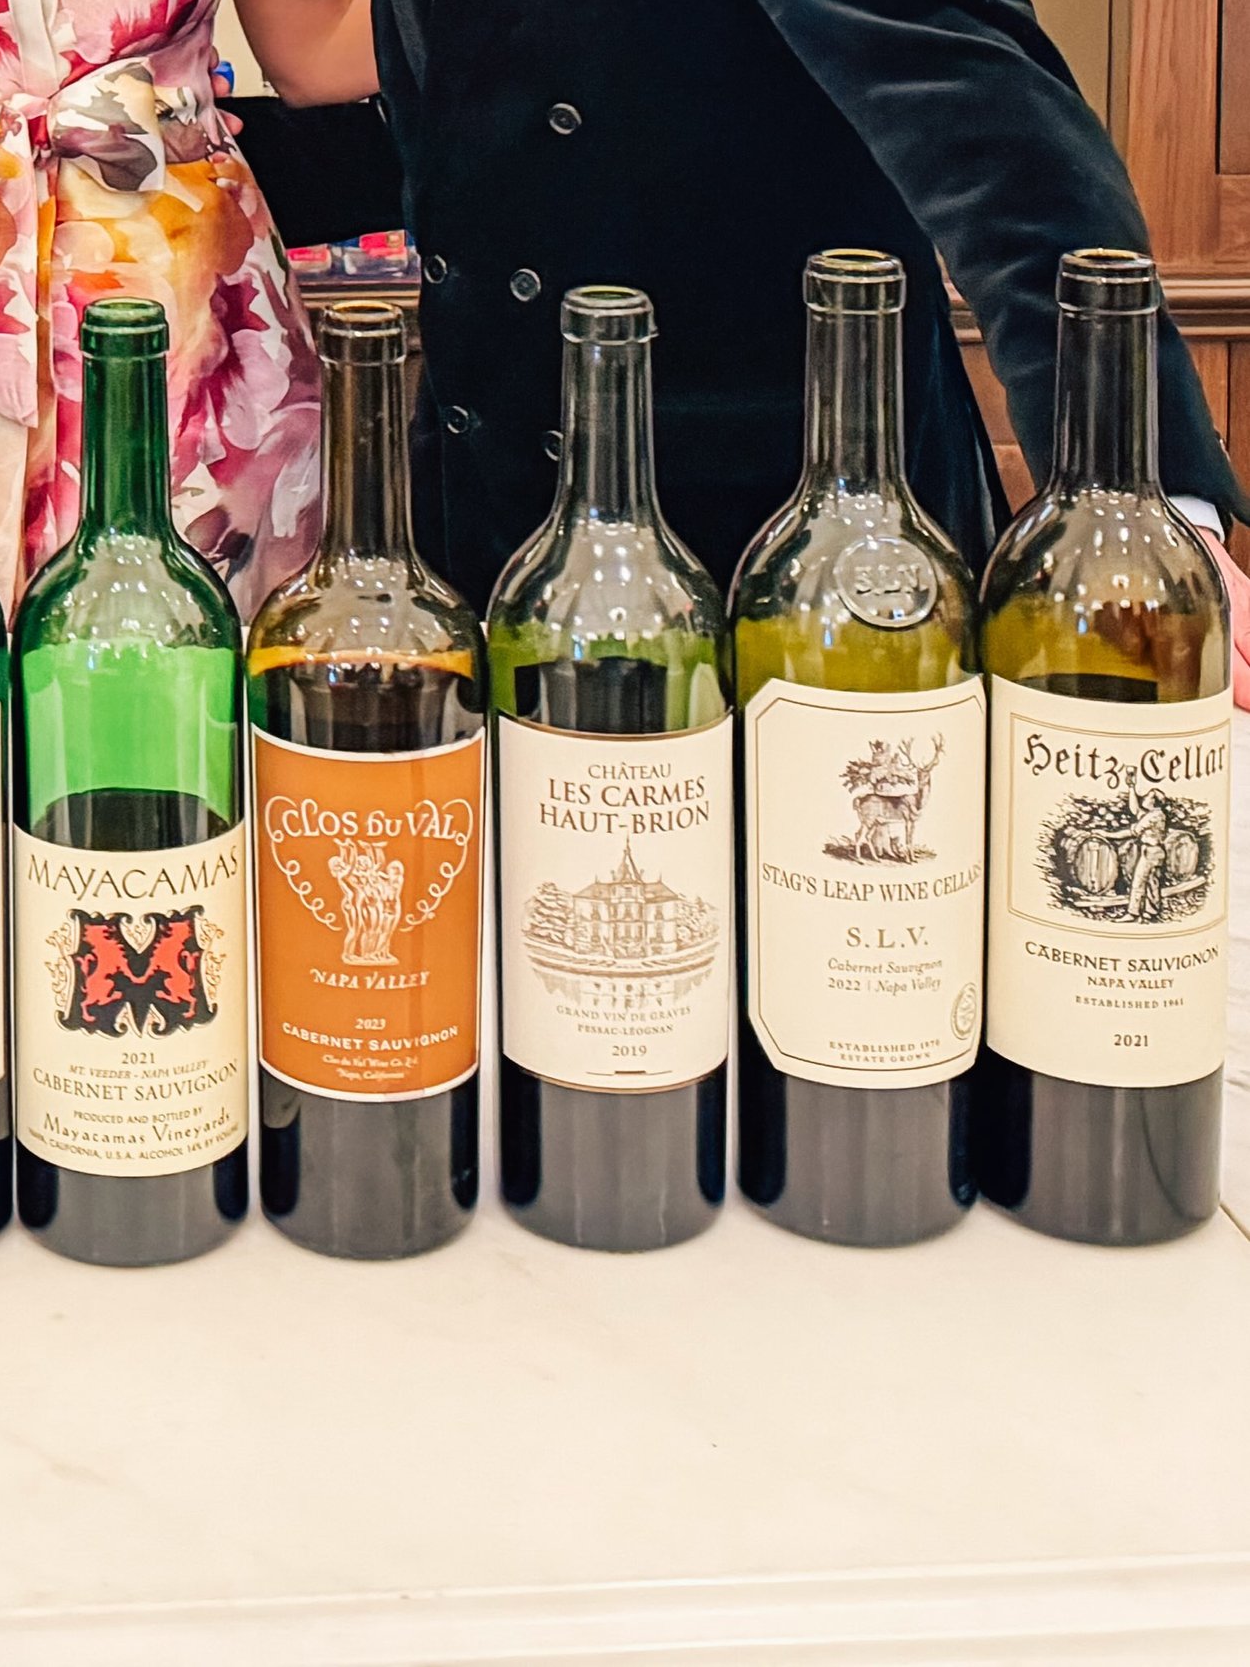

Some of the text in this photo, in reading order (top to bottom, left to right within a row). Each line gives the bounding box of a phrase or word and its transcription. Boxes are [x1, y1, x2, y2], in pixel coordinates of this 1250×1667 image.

[587, 761, 672, 780] CHÂTEAU
[1023, 733, 1226, 790] Heitz Cellar
[549, 775, 706, 807] LES CARMES
[281, 798, 360, 837] CLOS
[405, 799, 458, 840] VAL
[539, 800, 710, 834] HAUT-BRION
[26, 845, 239, 901] MAYACAMAS
[762, 861, 817, 896] STAG'S
[822, 879, 875, 902] LEAP
[878, 881, 929, 902] WINE
[828, 957, 943, 975] Cabernet Sauvignon
[1025, 940, 1220, 973] CABERNET SAUVIGNON
[309, 967, 431, 991] NAPA VALLEY
[827, 977, 942, 996] 2022 Napa Valley
[1087, 975, 1175, 990] NAPA VALLEY
[1075, 995, 1184, 1009] ESTABLISHED 1961
[556, 1005, 692, 1022] GRAND VIN DE GRAVES
[354, 1018, 387, 1031] 2023
[281, 1022, 459, 1052] CABERNET SAUVIGNON
[829, 1040, 916, 1053] ESTABLISHED
[1113, 1033, 1149, 1048] 2021
[121, 1051, 156, 1065] 2021
[611, 1045, 648, 1057] 2019
[840, 1052, 932, 1063] ESTATE GROWN
[90, 1068, 132, 1080] VEEDER
[141, 1068, 170, 1080] NAPA
[173, 1059, 209, 1075] VALLEY
[32, 1057, 239, 1102] CABERNET SAUVIGNON
[73, 1106, 204, 1124] PRODUCED AND BOTTLED BY
[43, 1112, 146, 1145] Mayacamas
[151, 1106, 230, 1142] Vineyards
